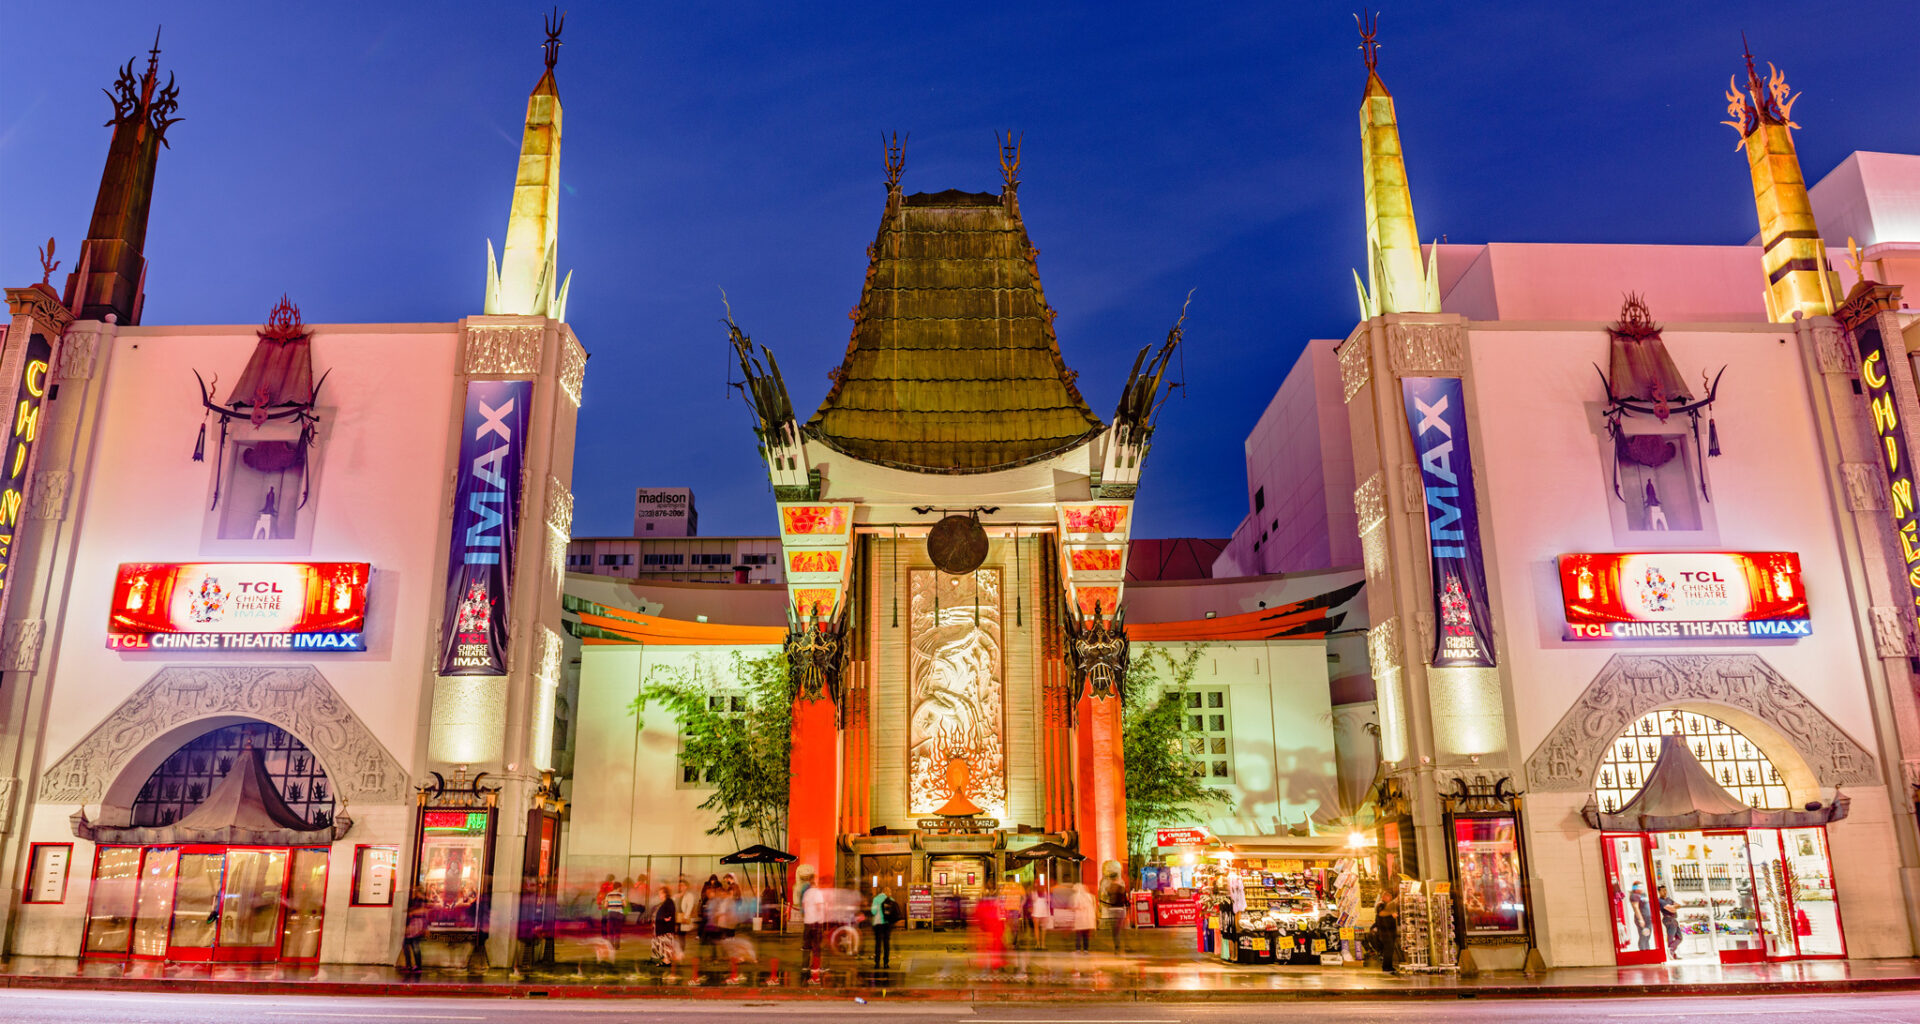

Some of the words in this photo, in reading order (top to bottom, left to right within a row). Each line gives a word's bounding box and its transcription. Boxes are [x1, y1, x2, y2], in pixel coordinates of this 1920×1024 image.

[464, 397, 514, 565] IMAX
[1415, 394, 1465, 558] IMAX
[639, 491, 686, 503] madison
[1680, 571, 1724, 583] TCL
[238, 582, 283, 593] TCL
[1681, 583, 1726, 592] CHINESE
[235, 594, 282, 603] CHINESE
[1683, 591, 1728, 599] THEATRE
[235, 602, 281, 611] THEATRE
[233, 610, 280, 618] IMAX
[1444, 625, 1475, 636] TCL
[1571, 623, 1613, 638] TCL
[1613, 622, 1680, 637] CHINESE
[1680, 621, 1748, 636] THEATRE
[1750, 620, 1811, 635] IMAX
[109, 633, 149, 648] TCL
[152, 633, 220, 648] CHINESE
[222, 633, 292, 648] THEATRE
[293, 633, 359, 648] IMAX
[458, 633, 489, 644] TCL
[1443, 648, 1481, 659] IMAX
[453, 656, 492, 667] IMAX
